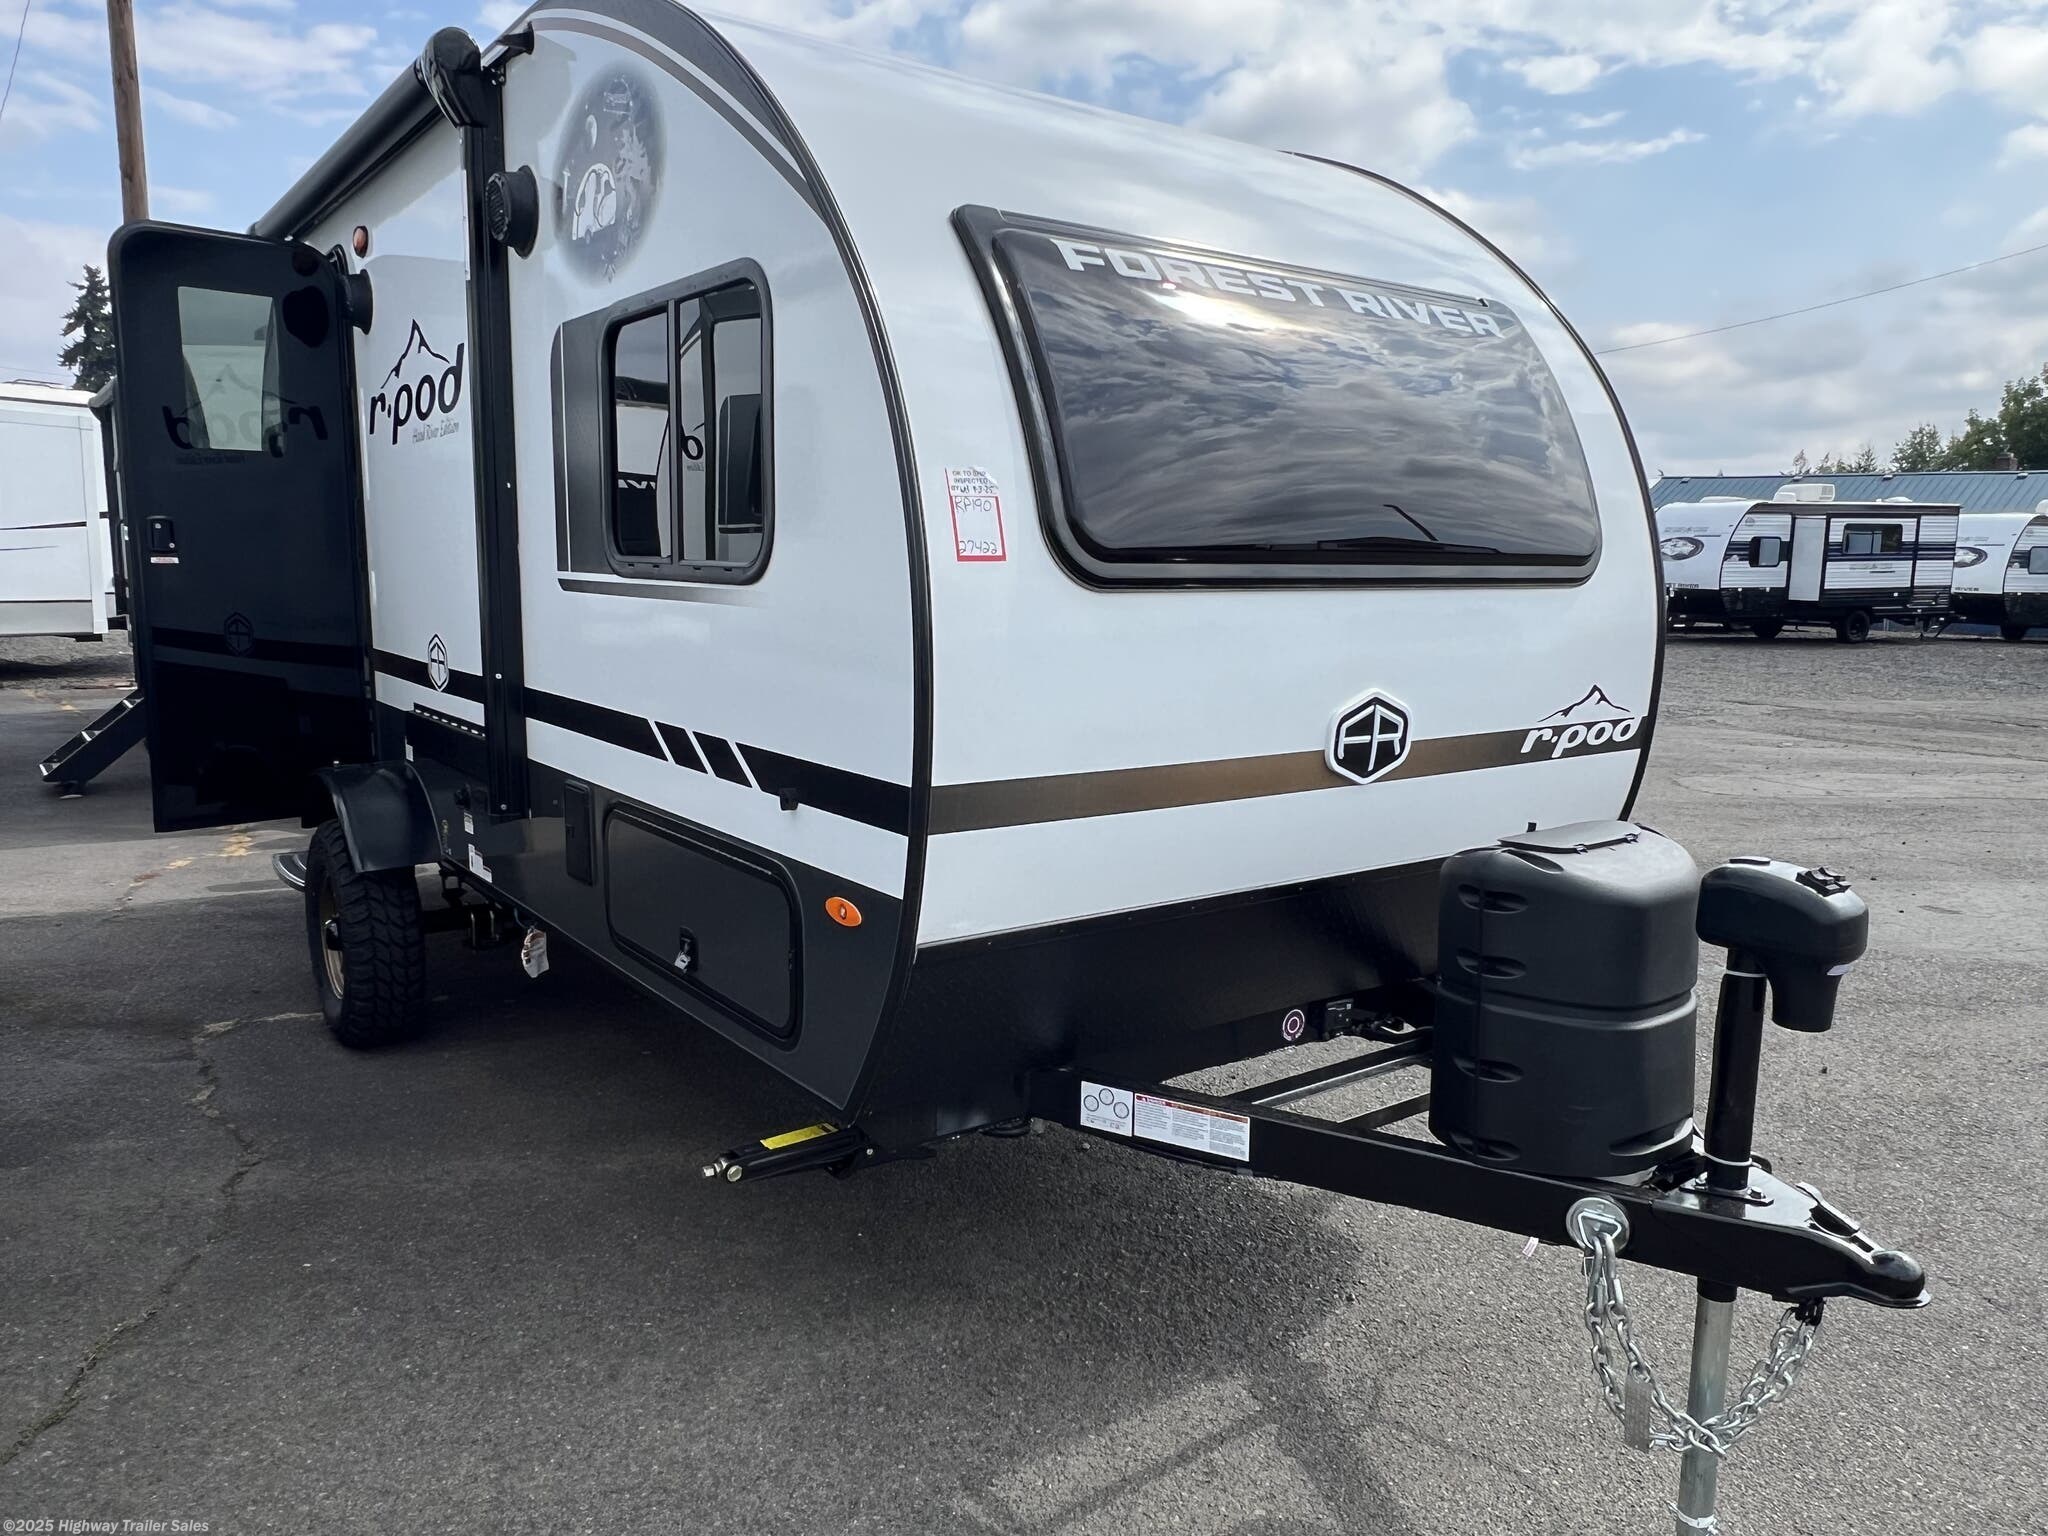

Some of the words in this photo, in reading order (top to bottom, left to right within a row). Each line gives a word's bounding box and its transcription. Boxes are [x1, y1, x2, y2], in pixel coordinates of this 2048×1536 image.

[1050, 239, 1325, 307] FOREST
[1334, 288, 1505, 338] RIVER
[955, 496, 992, 512] RP190
[959, 540, 997, 554] 27422
